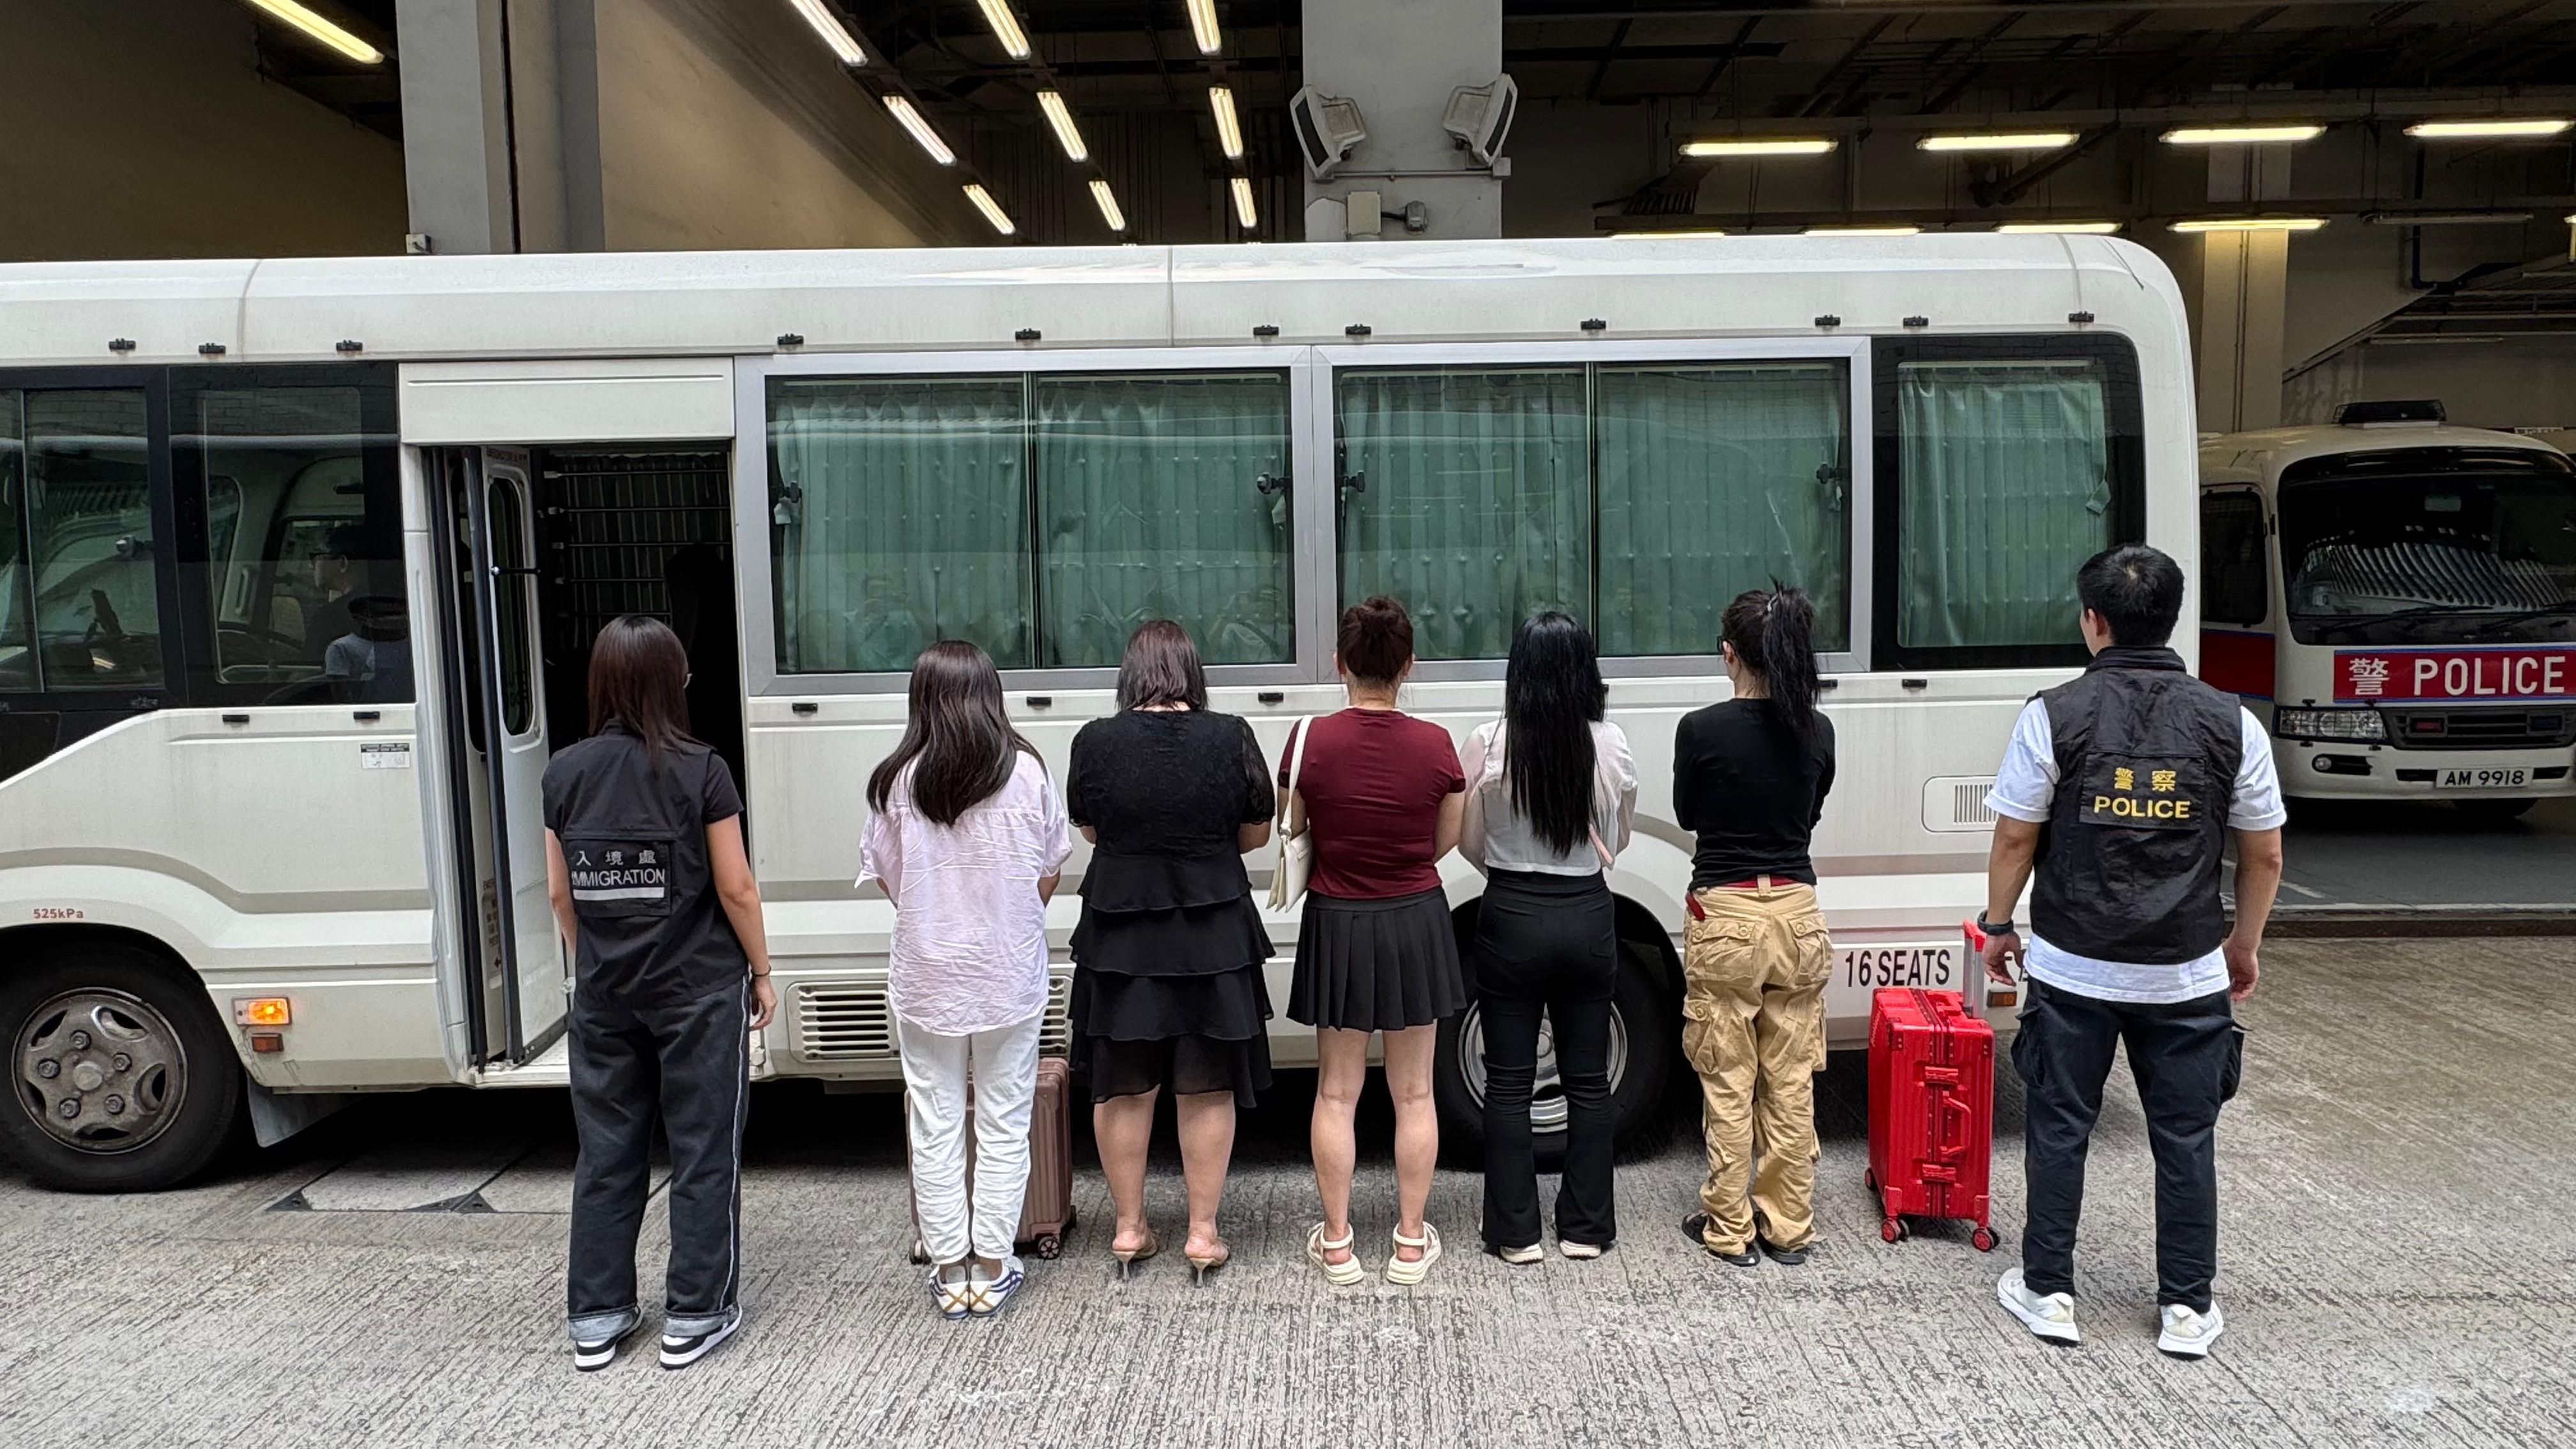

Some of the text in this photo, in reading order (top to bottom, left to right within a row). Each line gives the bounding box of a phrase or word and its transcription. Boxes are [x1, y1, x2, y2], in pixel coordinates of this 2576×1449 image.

[2349, 656, 2565, 696] 警 POLICE
[2114, 767, 2177, 792] 警察
[2445, 770, 2524, 786] AM 9918
[2094, 795, 2191, 818] POLICE
[33, 908, 84, 919] 525kPa
[1845, 951, 1873, 987] 16
[1876, 949, 1951, 986] SEATS
